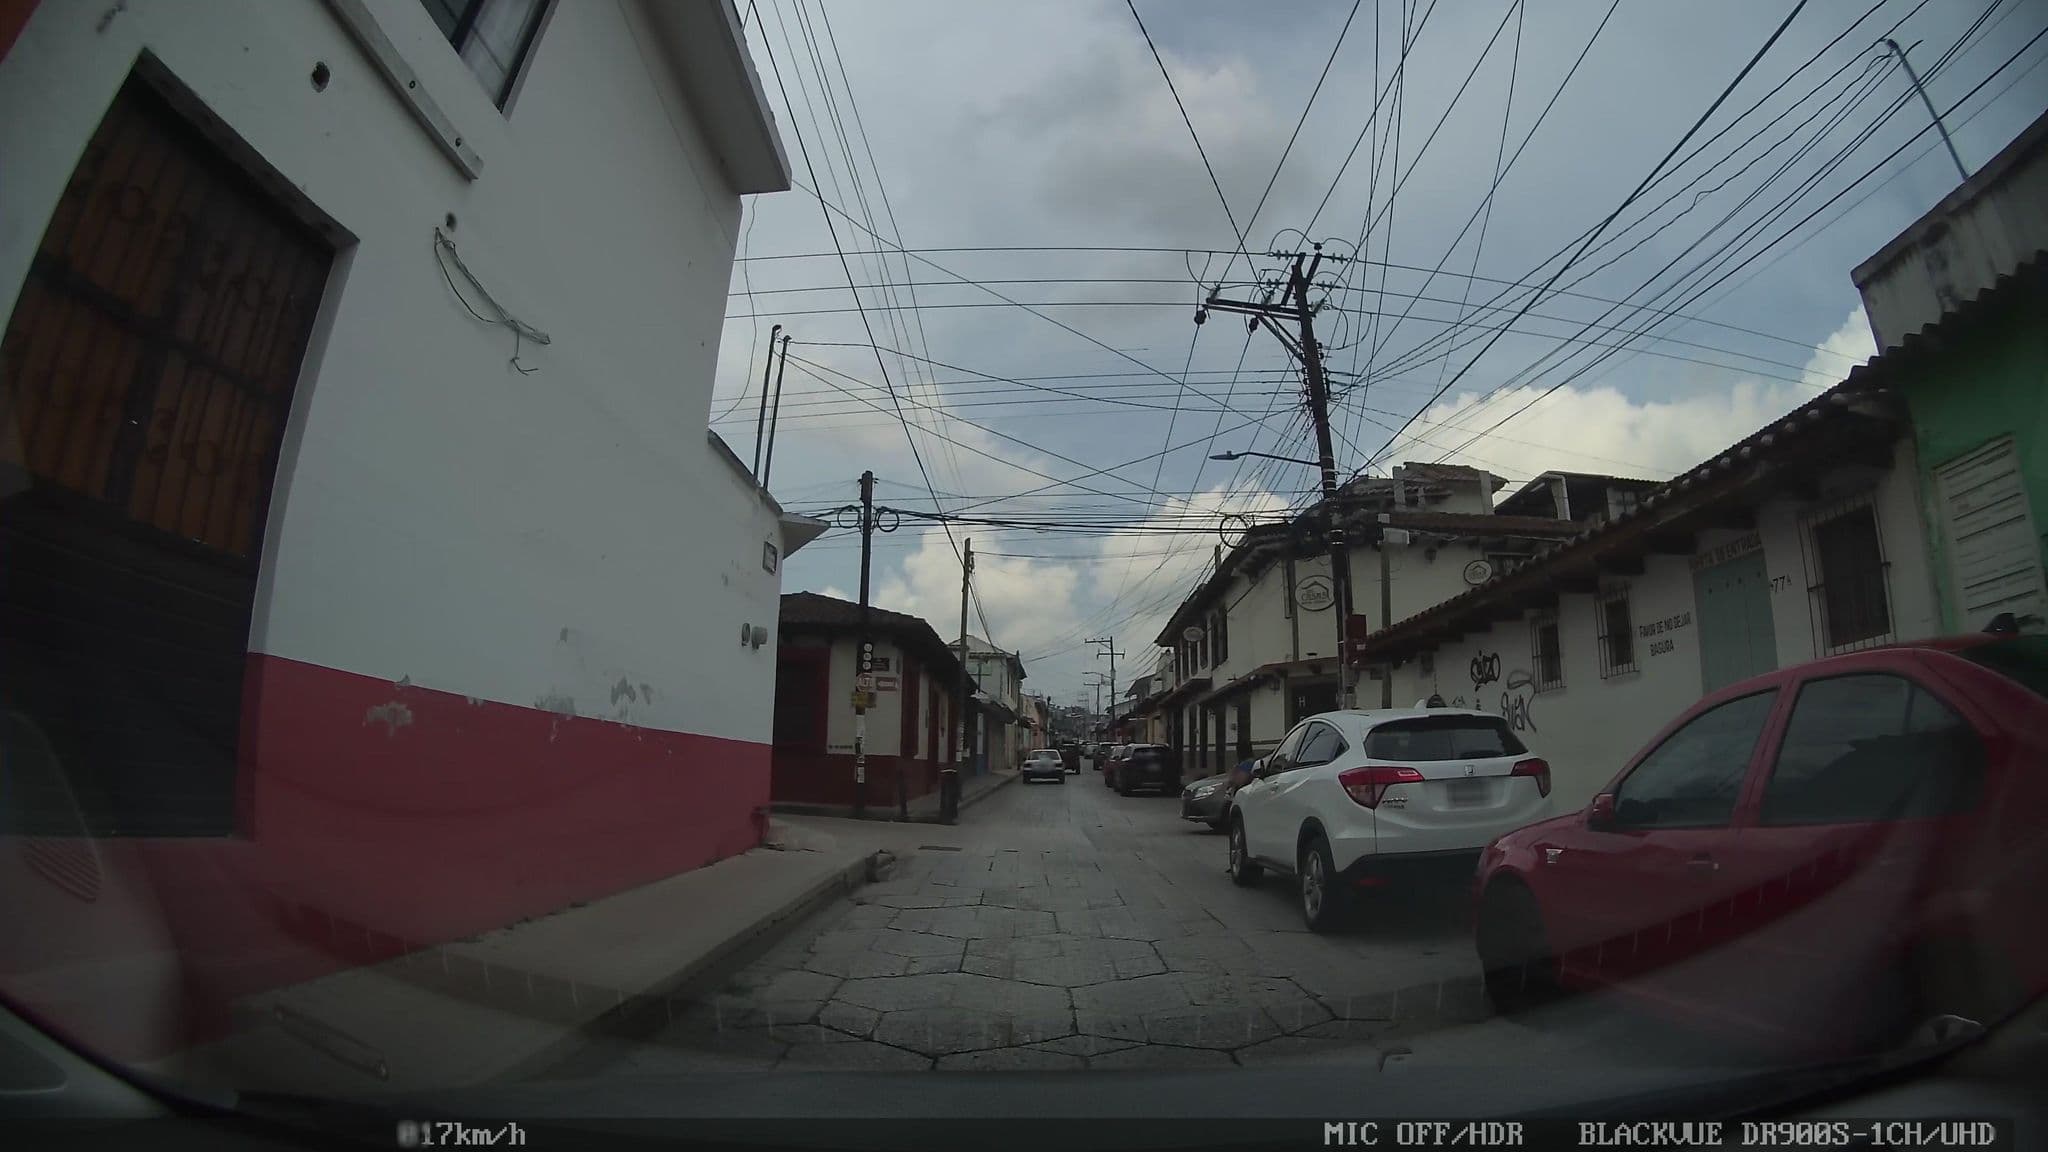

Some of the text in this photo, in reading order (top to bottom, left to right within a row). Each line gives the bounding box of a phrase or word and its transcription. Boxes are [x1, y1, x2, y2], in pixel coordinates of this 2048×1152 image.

[1640, 624, 1656, 638] FAVOR
[1656, 621, 1664, 634] DE
[1664, 618, 1673, 631] NO
[1650, 640, 1674, 656] BASURA
